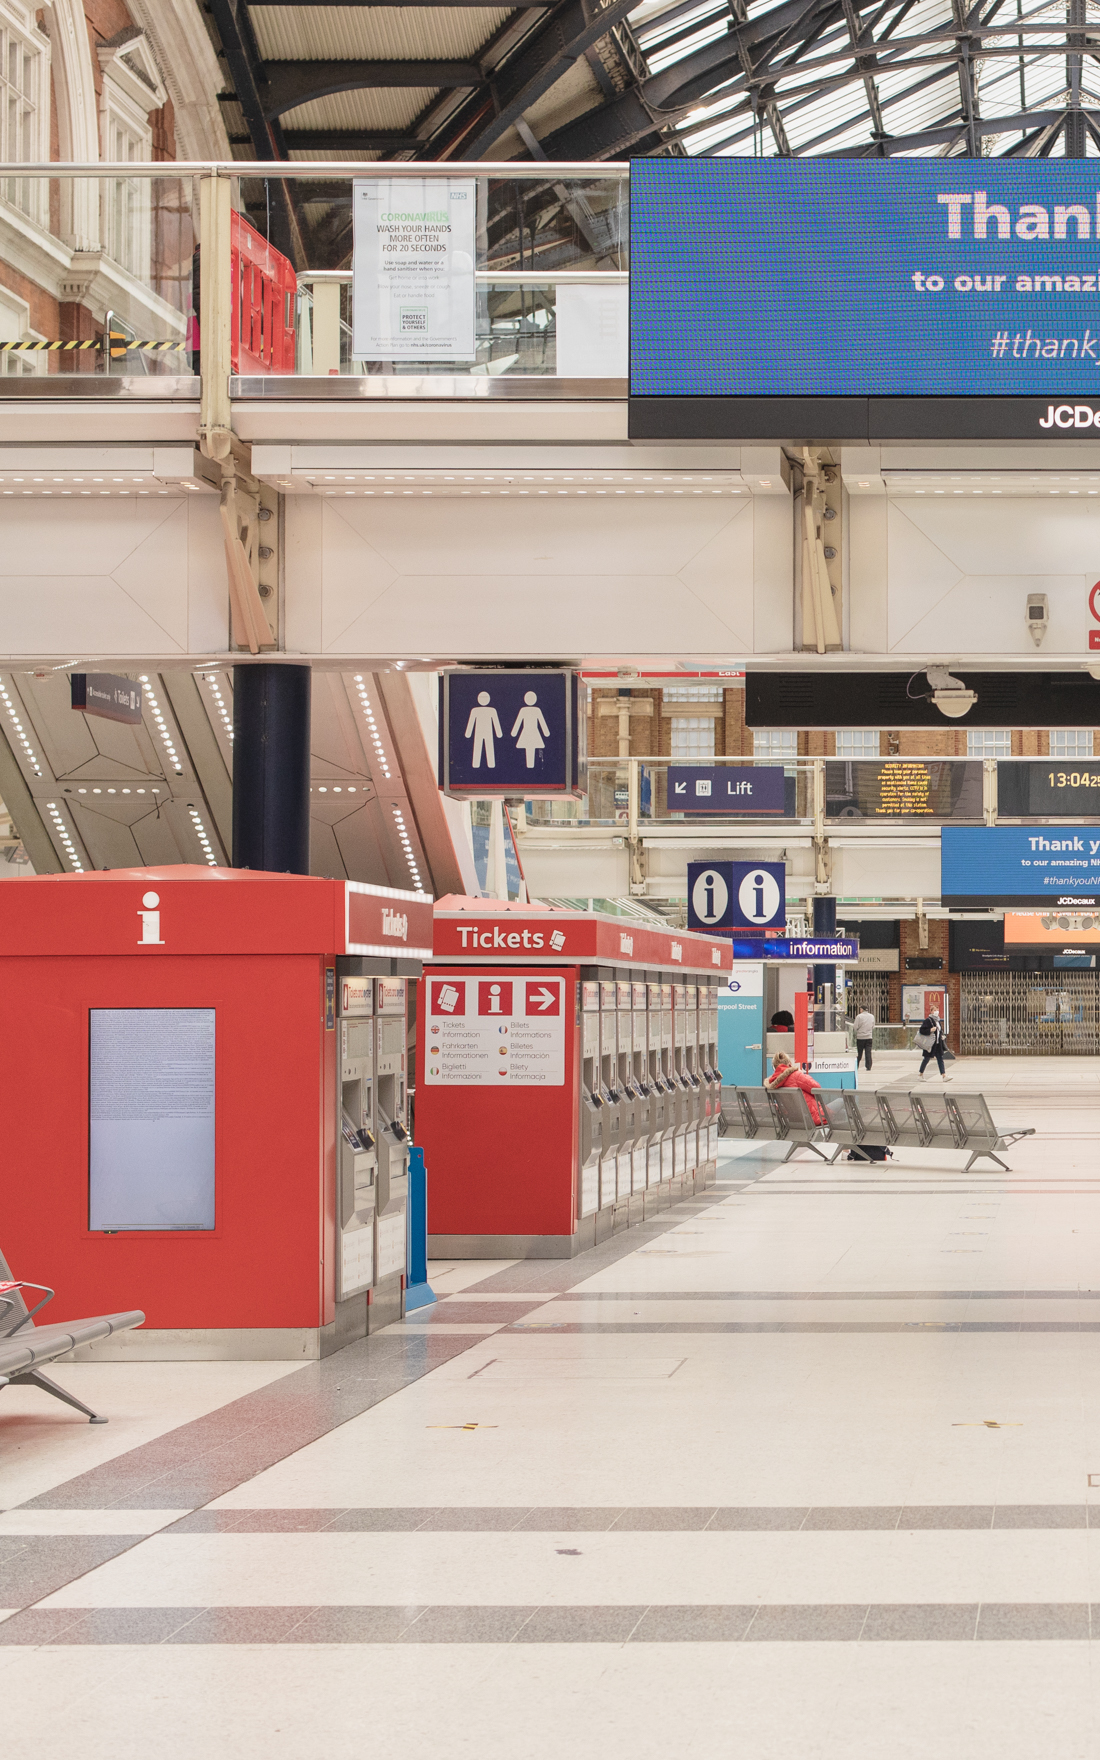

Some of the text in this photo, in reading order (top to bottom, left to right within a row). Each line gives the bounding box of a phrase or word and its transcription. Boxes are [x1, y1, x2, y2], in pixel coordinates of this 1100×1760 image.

[381, 212, 449, 222] CORONAVIRUS
[382, 244, 397, 252] FOR
[911, 271, 945, 293] to
[954, 272, 1006, 293] our
[728, 781, 752, 794] Lift
[1028, 836, 1084, 851] Thank
[1051, 859, 1088, 867] amazing
[457, 927, 544, 948] Tickets
[790, 942, 852, 955] information
[717, 1003, 737, 1011] erpool
[442, 1063, 466, 1071] Biglietti
[510, 1073, 545, 1081] Informacja
